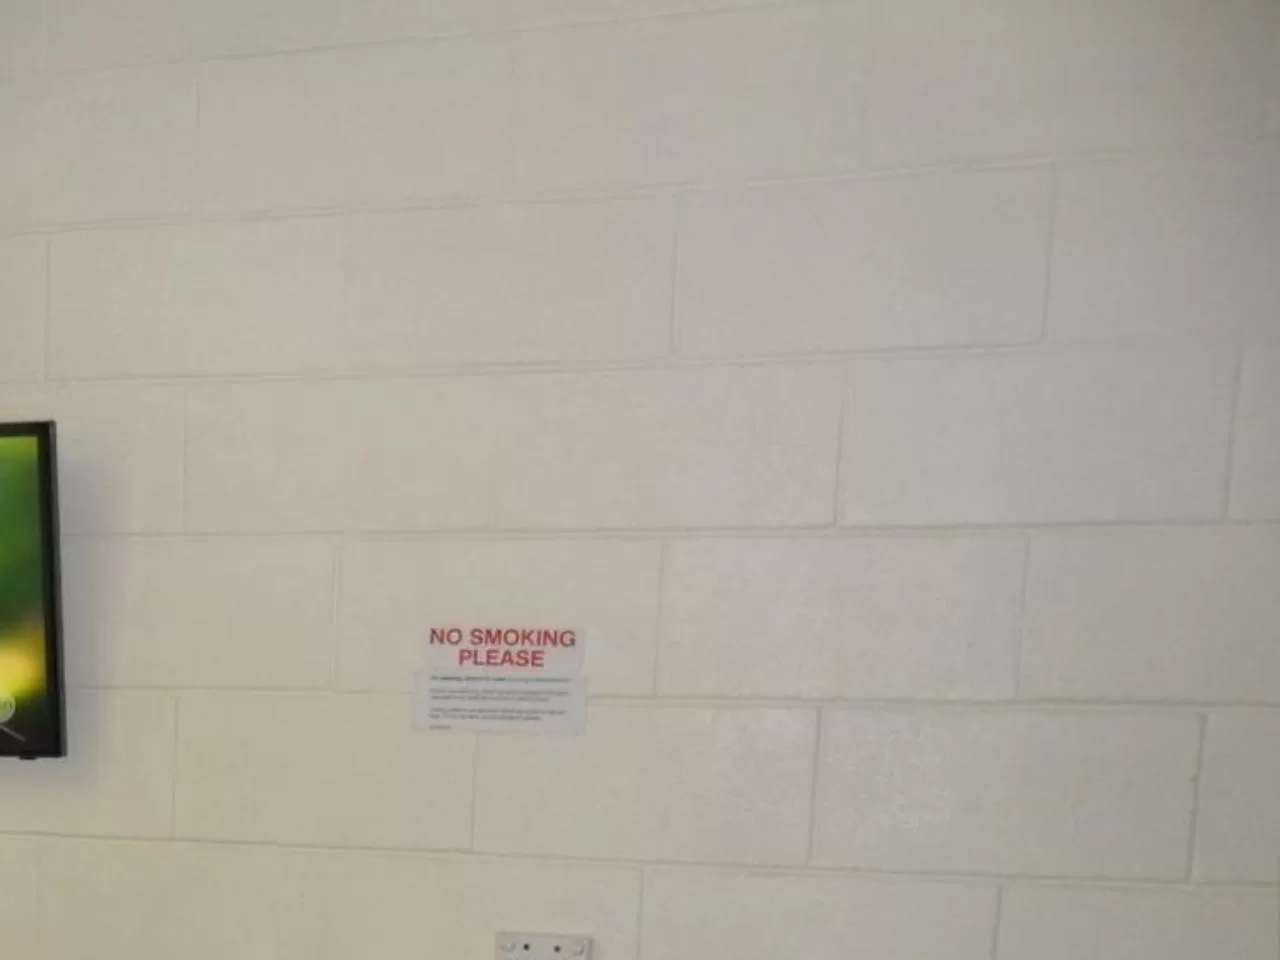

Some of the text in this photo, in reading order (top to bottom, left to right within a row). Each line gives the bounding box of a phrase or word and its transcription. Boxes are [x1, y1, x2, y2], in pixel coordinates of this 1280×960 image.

[429, 627, 576, 648] NO SMOKING
[458, 649, 545, 667] PLEASE
